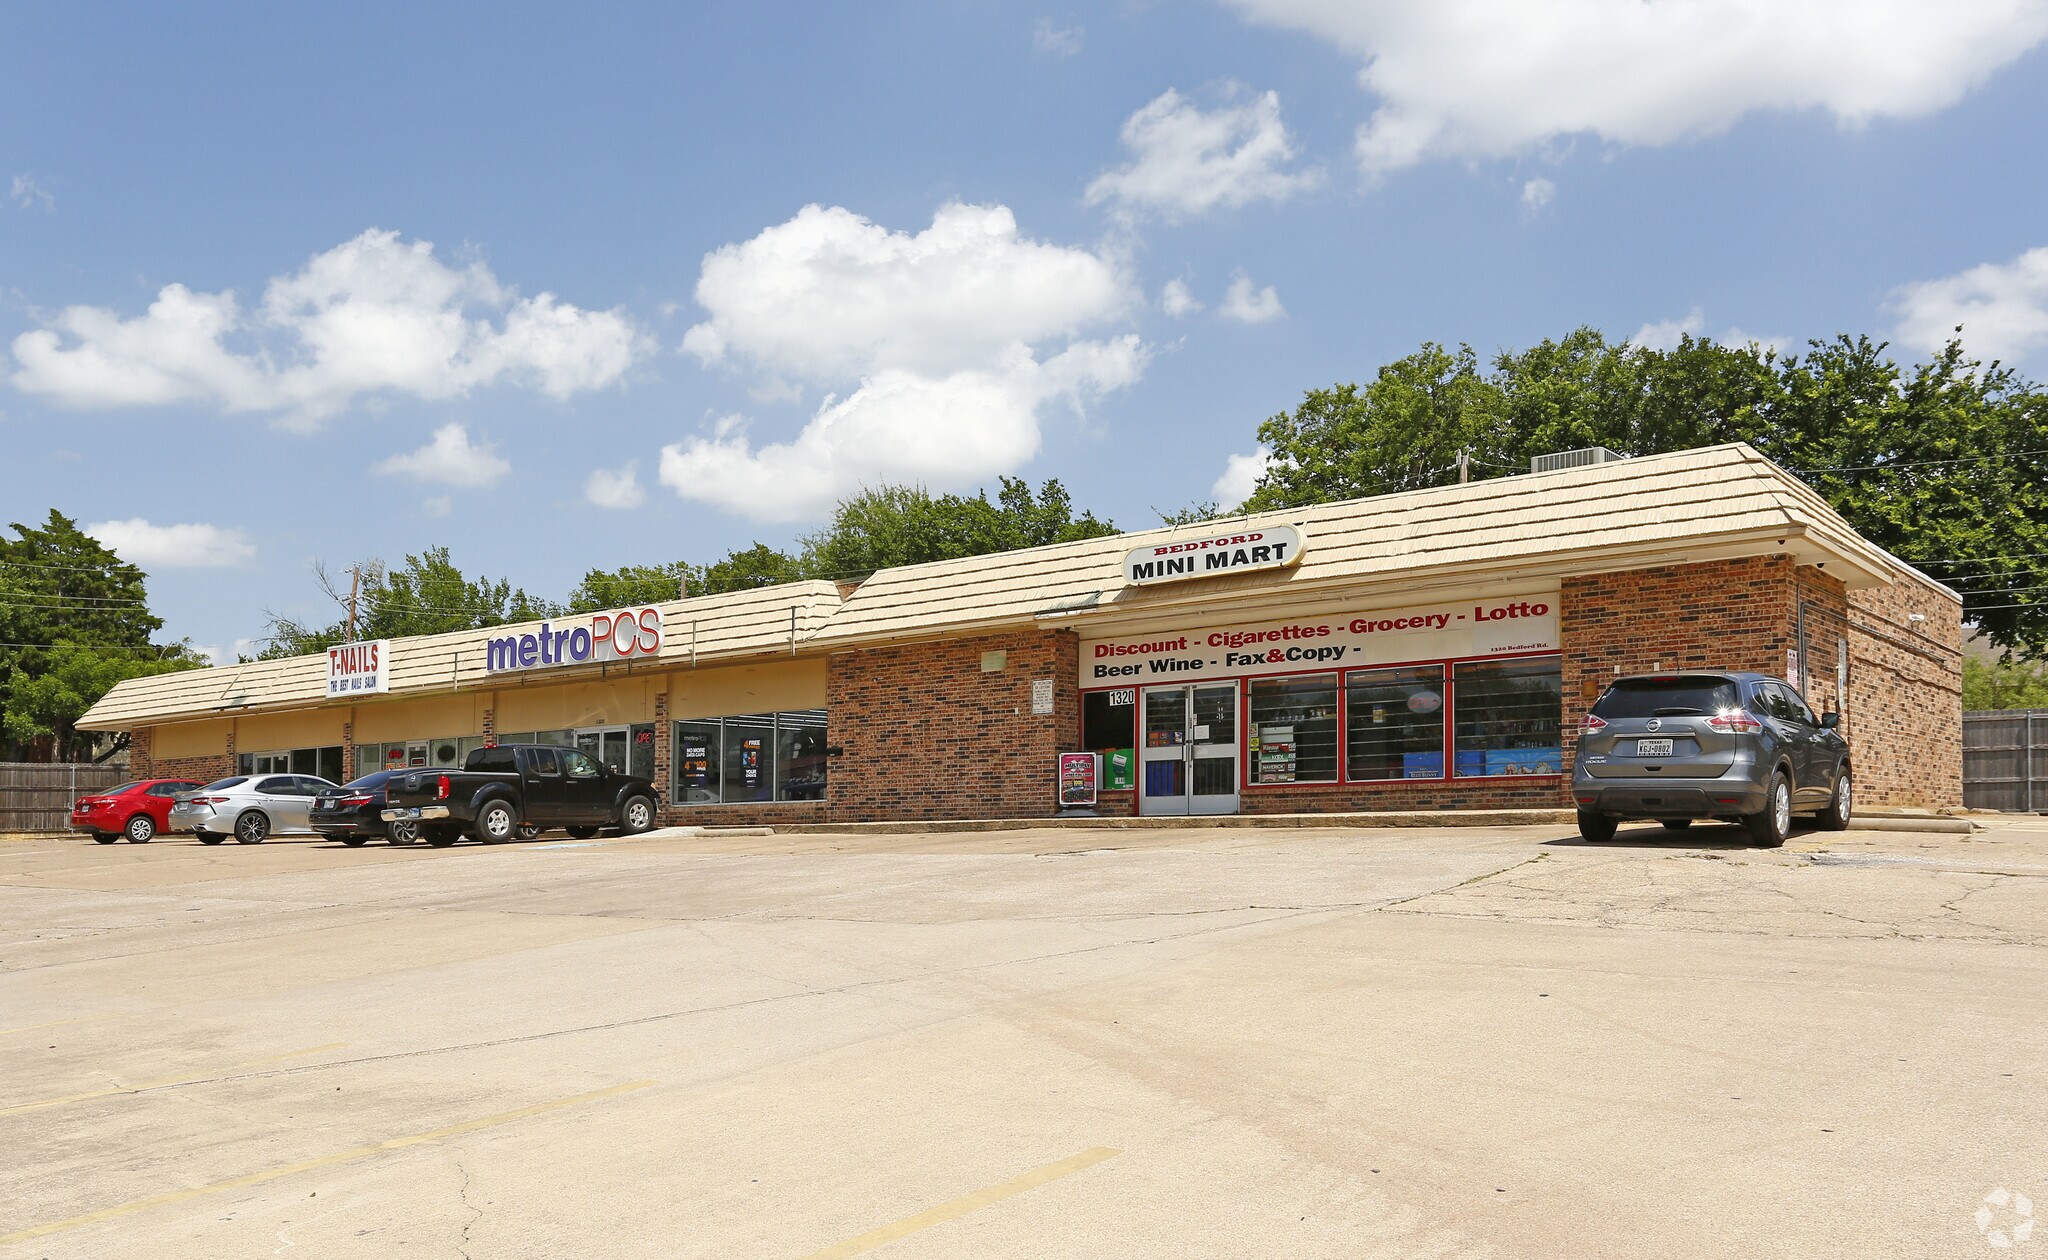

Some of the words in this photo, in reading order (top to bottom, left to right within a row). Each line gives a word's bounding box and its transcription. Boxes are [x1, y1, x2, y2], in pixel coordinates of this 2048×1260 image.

[1154, 533, 1264, 556] BEDFORD
[1132, 556, 1195, 580] MINI
[1205, 542, 1288, 570] MART
[486, 608, 660, 671] metroPCS
[1094, 636, 1188, 658] Discount
[1207, 625, 1331, 648] Cigarettes
[1349, 612, 1450, 635] Grocery
[1474, 602, 1549, 622] Lotto
[329, 643, 378, 677] T-NAILS
[1507, 643, 1536, 651] Bedford
[1094, 664, 1143, 678] Beer
[1148, 658, 1204, 673] Wine
[1226, 645, 1347, 667] Fax&Copy
[330, 680, 338, 692] THE
[340, 679, 349, 691] BEST
[1110, 690, 1134, 705] 1320
[1064, 762, 1092, 770] MULTIPLY
